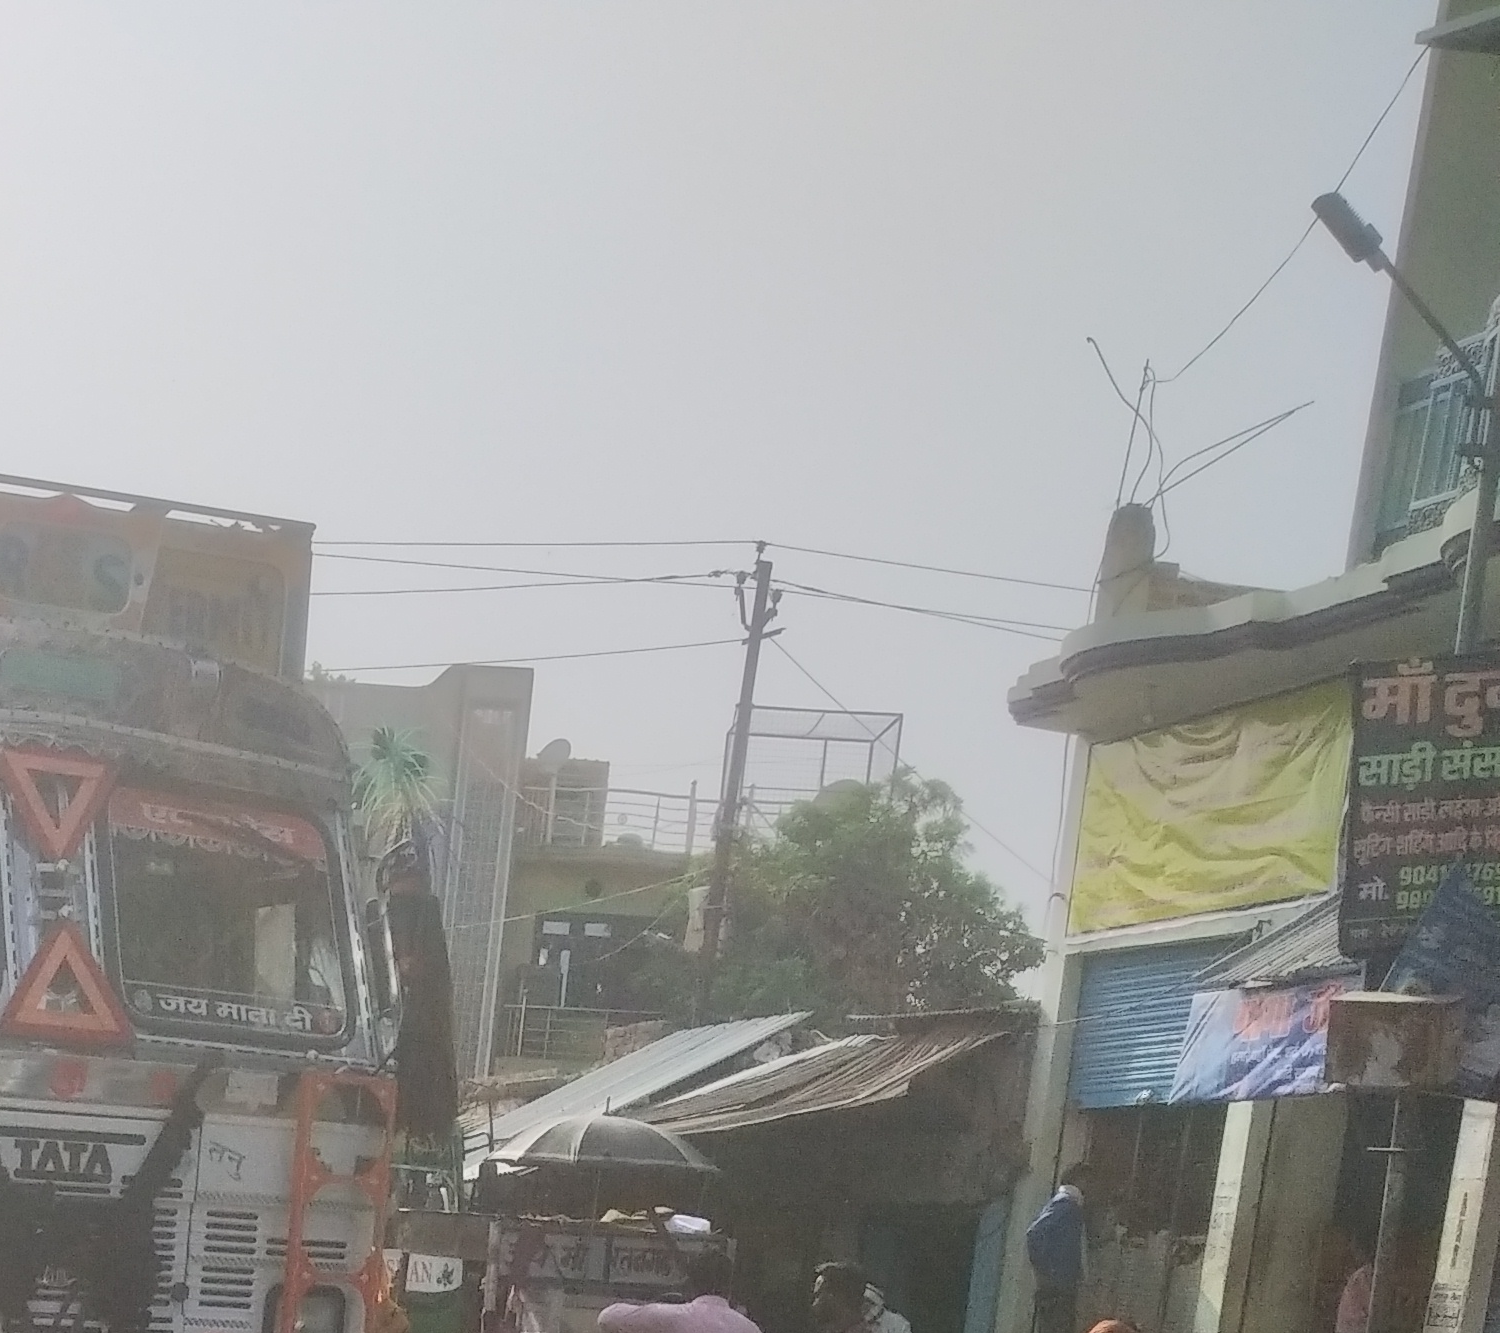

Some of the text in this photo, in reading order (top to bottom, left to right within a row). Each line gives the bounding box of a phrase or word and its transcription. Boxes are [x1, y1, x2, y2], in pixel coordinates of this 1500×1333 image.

[1443, 670, 1500, 738] दु
[156, 993, 208, 1016] जय
[14, 1138, 113, 1176] TATA
